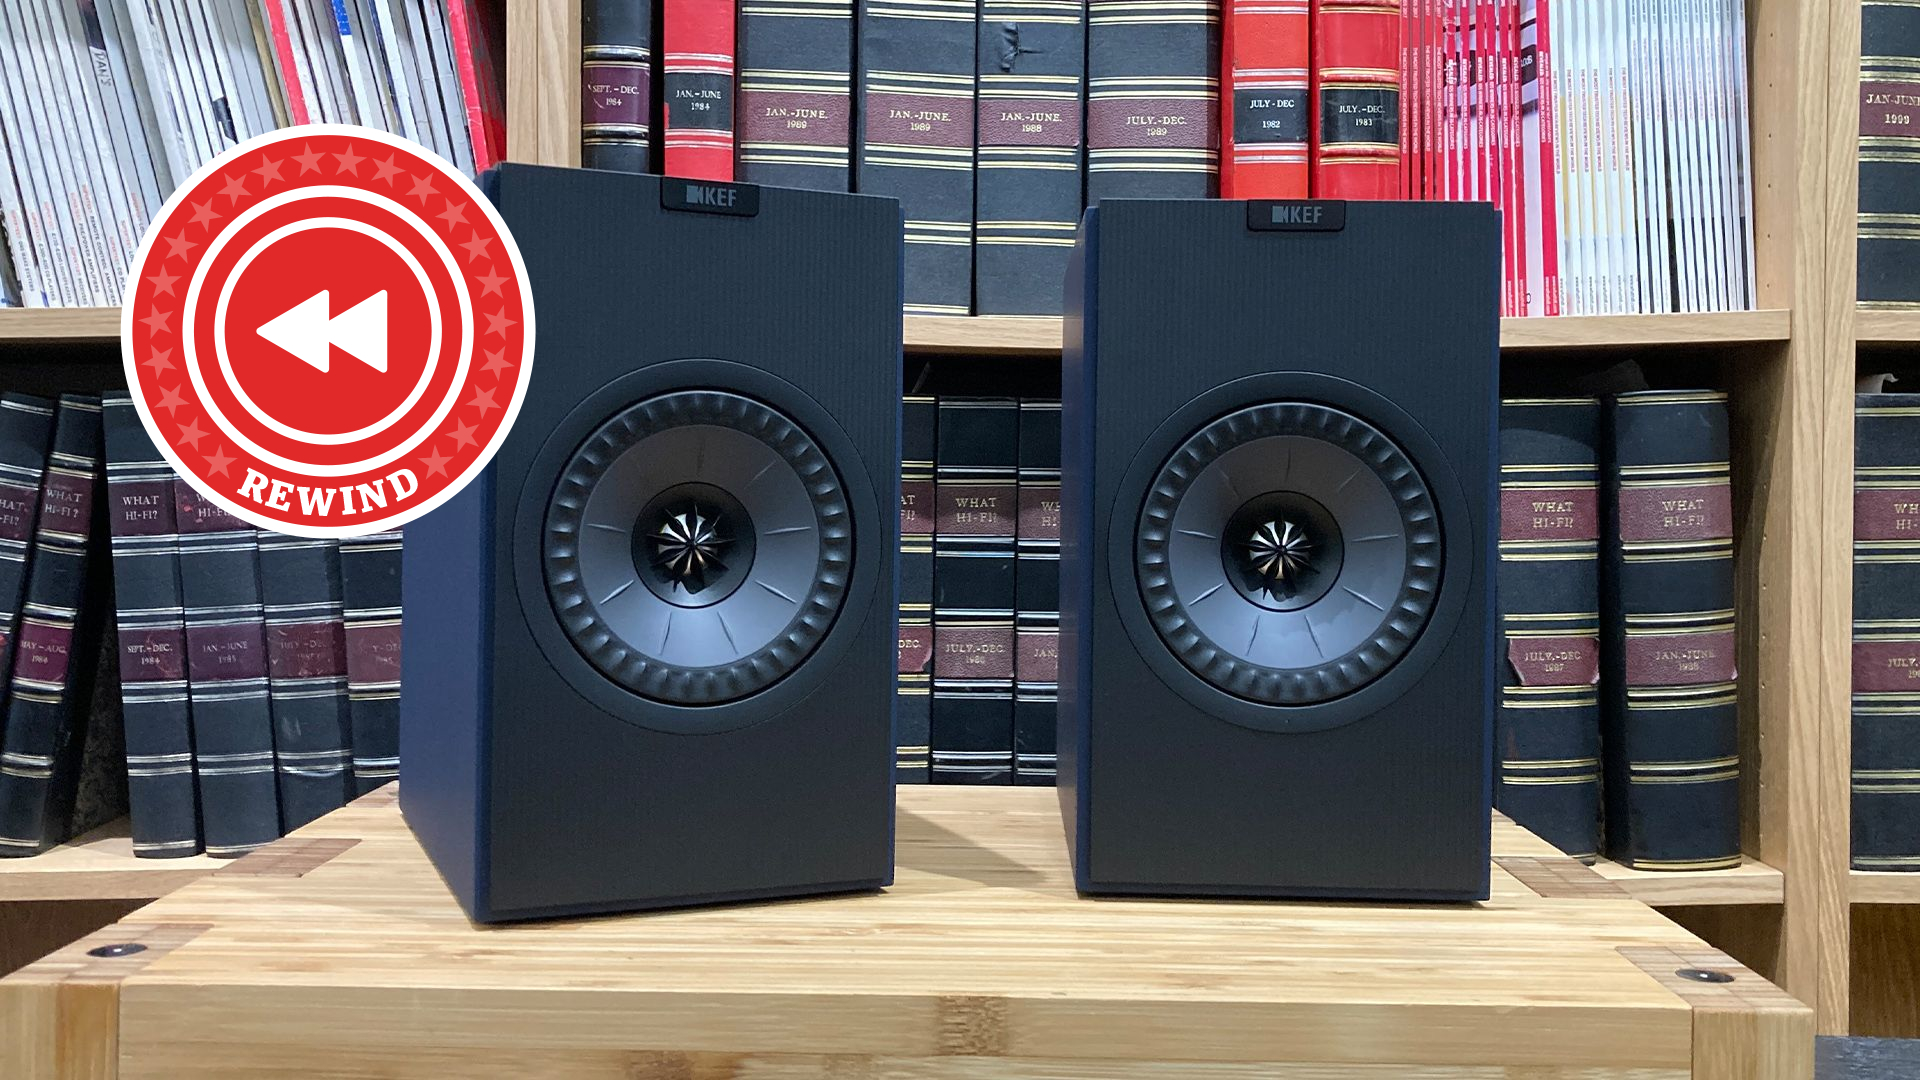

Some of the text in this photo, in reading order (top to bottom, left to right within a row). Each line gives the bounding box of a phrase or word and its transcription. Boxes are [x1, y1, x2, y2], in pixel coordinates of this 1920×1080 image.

[606, 98, 622, 106] 1984
[691, 102, 710, 111] 1984
[1250, 100, 1271, 108] JULY
[1355, 118, 1372, 126] 1983
[1884, 114, 1910, 124] 1999
[787, 120, 807, 129] 1989
[910, 122, 930, 132] 1989
[1022, 124, 1042, 133] 1988
[1147, 127, 1167, 136] 1989
[705, 187, 736, 207] KEF
[1290, 206, 1322, 223] KEF
[47, 489, 83, 502] WHAT
[122, 496, 159, 505] WHAT
[956, 498, 997, 508] WHAT
[1532, 501, 1573, 512] WHAT
[1662, 500, 1704, 511] WHAT
[125, 510, 158, 520] HI-FI?
[1532, 517, 1573, 528] HI-FI?
